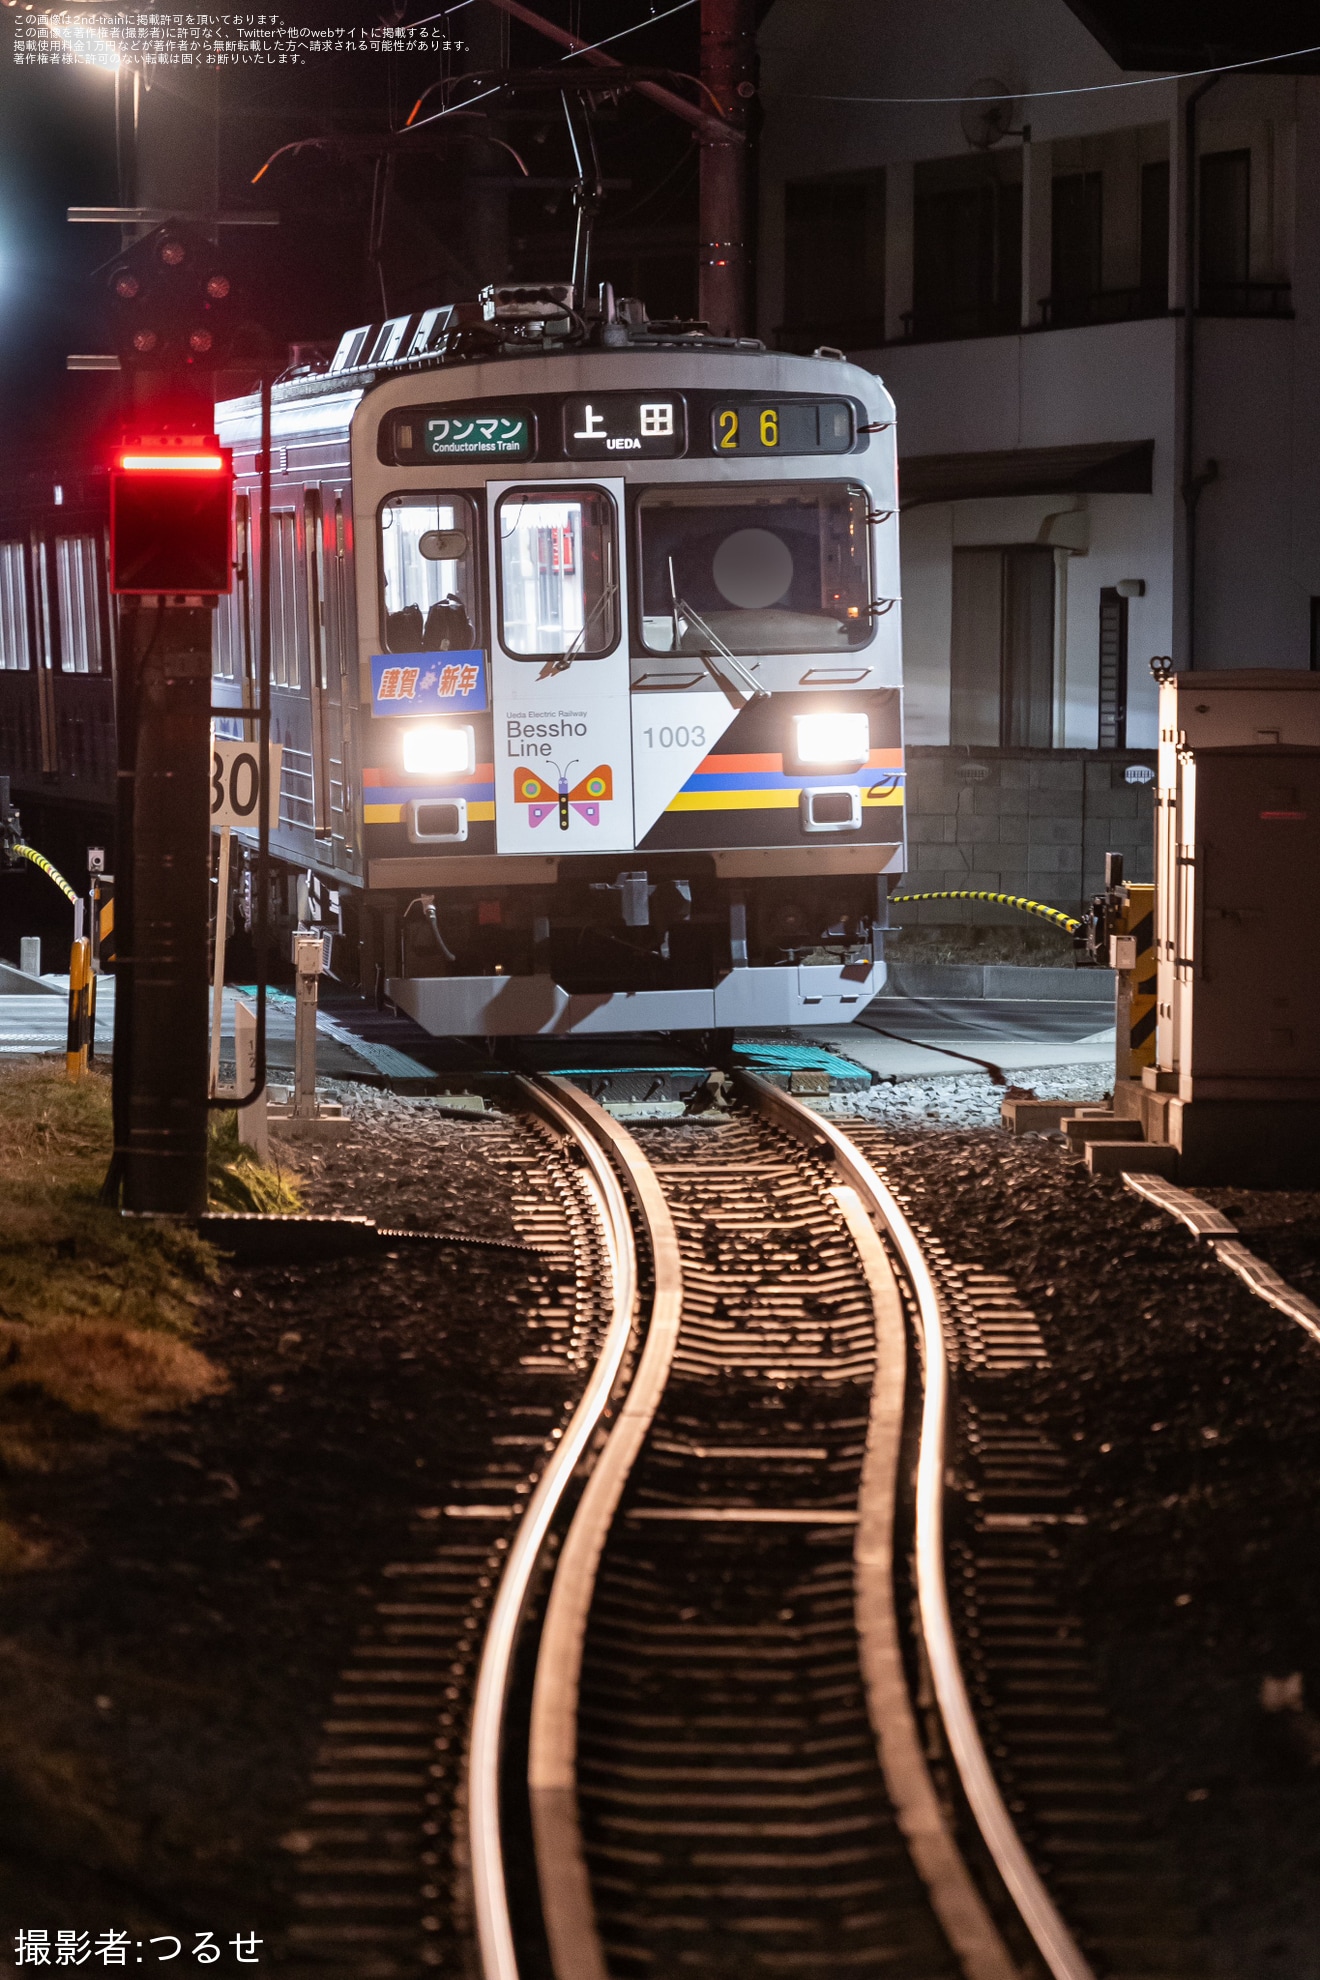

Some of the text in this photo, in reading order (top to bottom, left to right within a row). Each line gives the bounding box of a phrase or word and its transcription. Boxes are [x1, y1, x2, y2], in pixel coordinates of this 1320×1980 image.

[428, 418, 523, 441] ワンマン
[432, 440, 520, 453] Conductorless Train
[606, 438, 641, 450] UEDA
[527, 710, 556, 719] Electric
[558, 710, 587, 719] Railway
[507, 720, 587, 738] Bessho
[643, 726, 706, 748] 1003
[507, 740, 552, 757] Line
